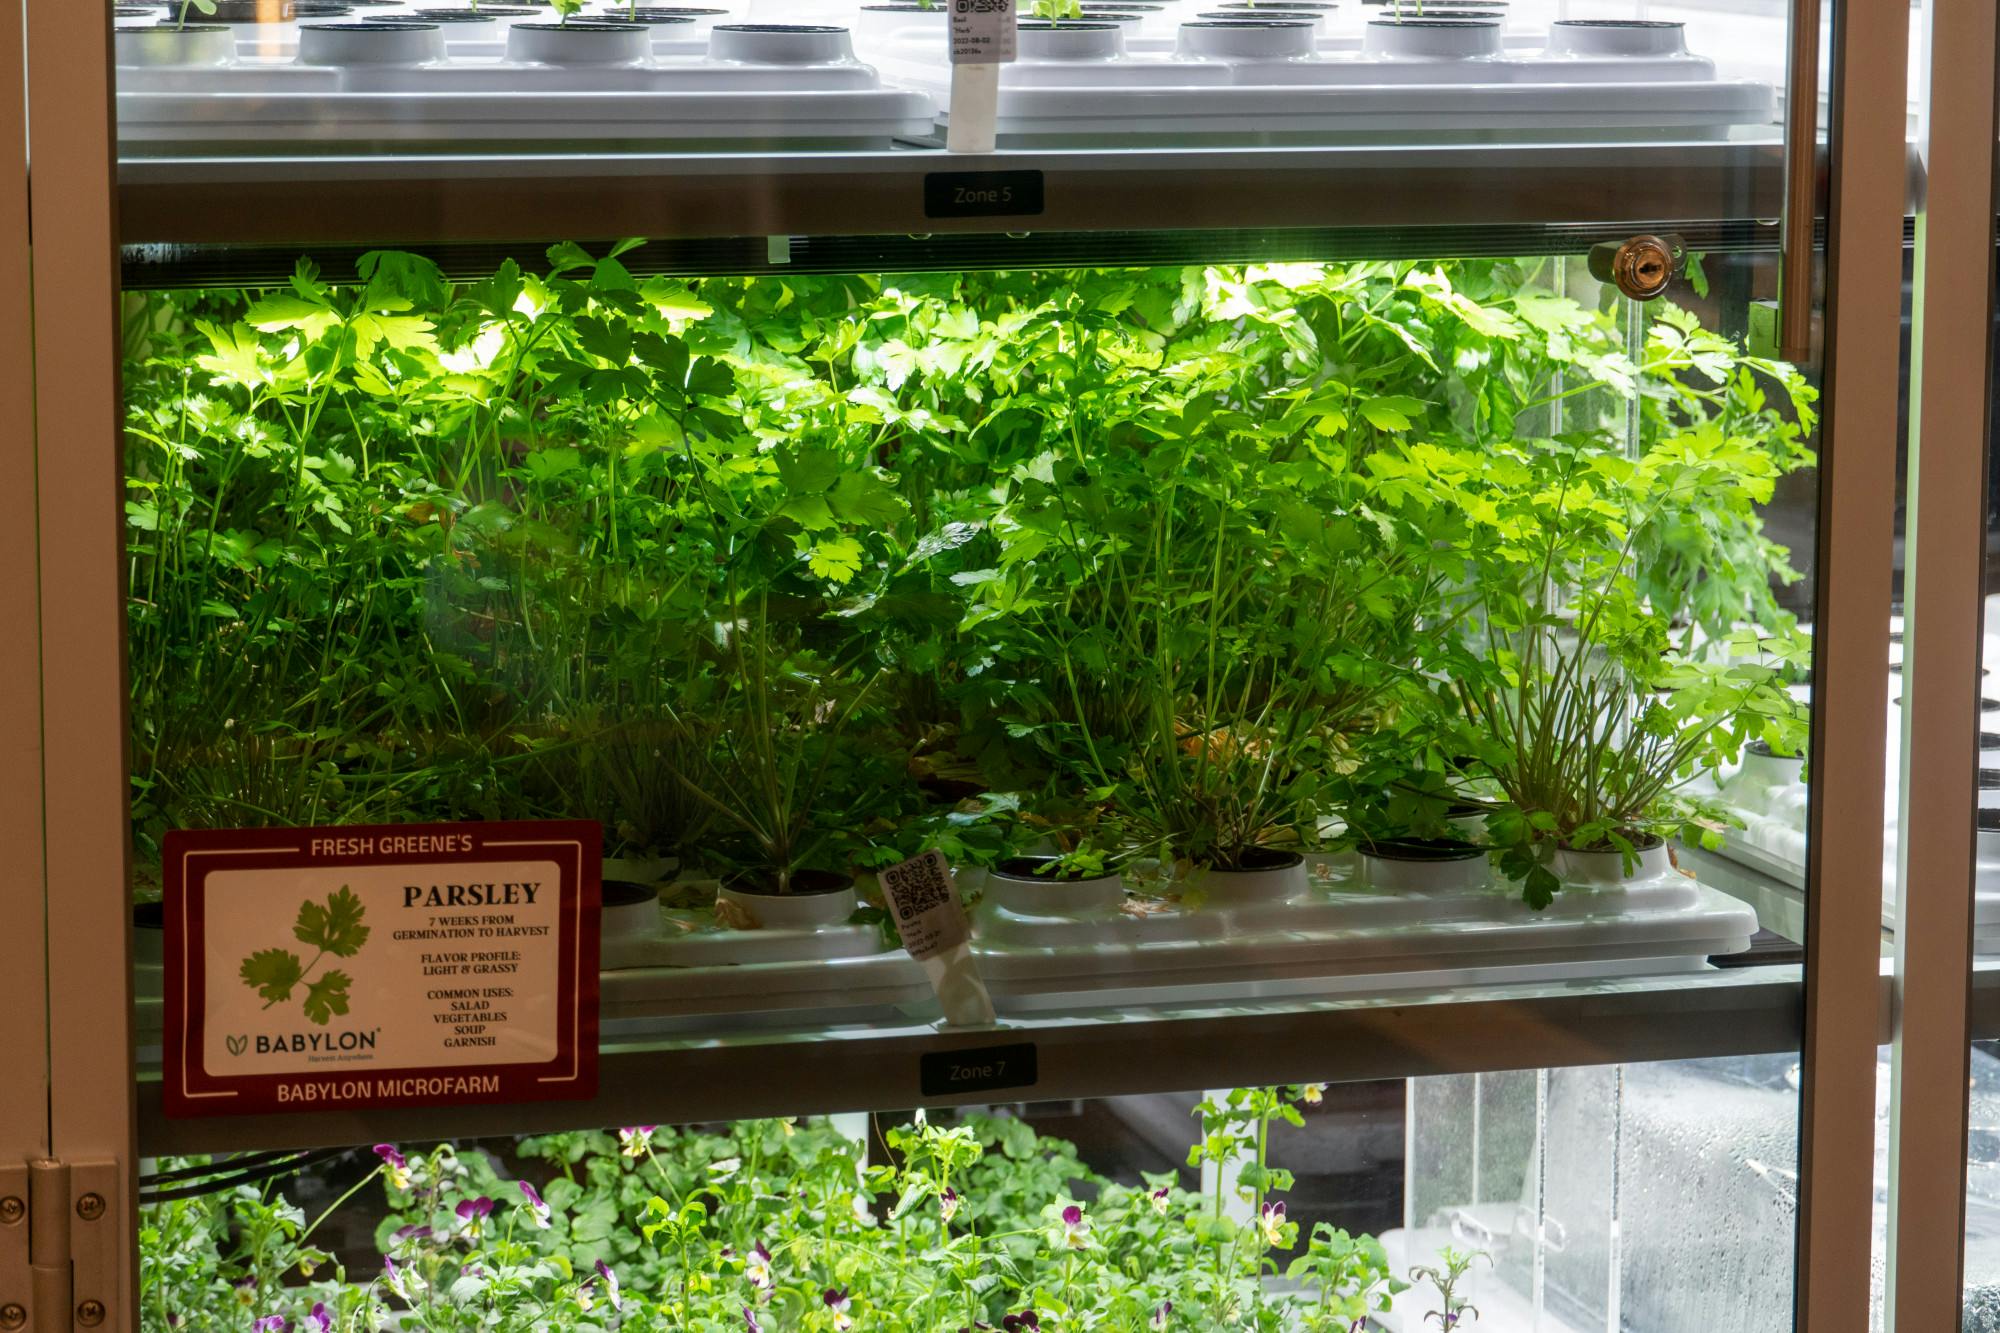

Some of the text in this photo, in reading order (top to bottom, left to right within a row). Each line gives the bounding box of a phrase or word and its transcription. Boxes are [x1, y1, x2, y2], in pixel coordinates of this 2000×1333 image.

[953, 186, 1012, 204] Zone 5
[311, 834, 473, 856] FRESH GREENE'S
[403, 882, 541, 907] PARSLEY
[428, 915, 514, 926] 7 WEEKS FROM
[392, 926, 550, 940] GERMINATION TO HARVEST
[421, 951, 521, 963] FLAVOR PROFILE:
[423, 963, 519, 976] LIGHT & GRASSY
[427, 988, 513, 1000] COMMON USES:
[451, 1001, 490, 1011] SALAD
[433, 1012, 508, 1024] VEGETABLES
[454, 1025, 486, 1035] SOUP
[256, 1031, 375, 1053] BABYLON
[444, 1036, 497, 1048] GARNISH
[949, 1060, 1007, 1081] Zone 7
[277, 1075, 500, 1102] BABYLON MICROFARM
